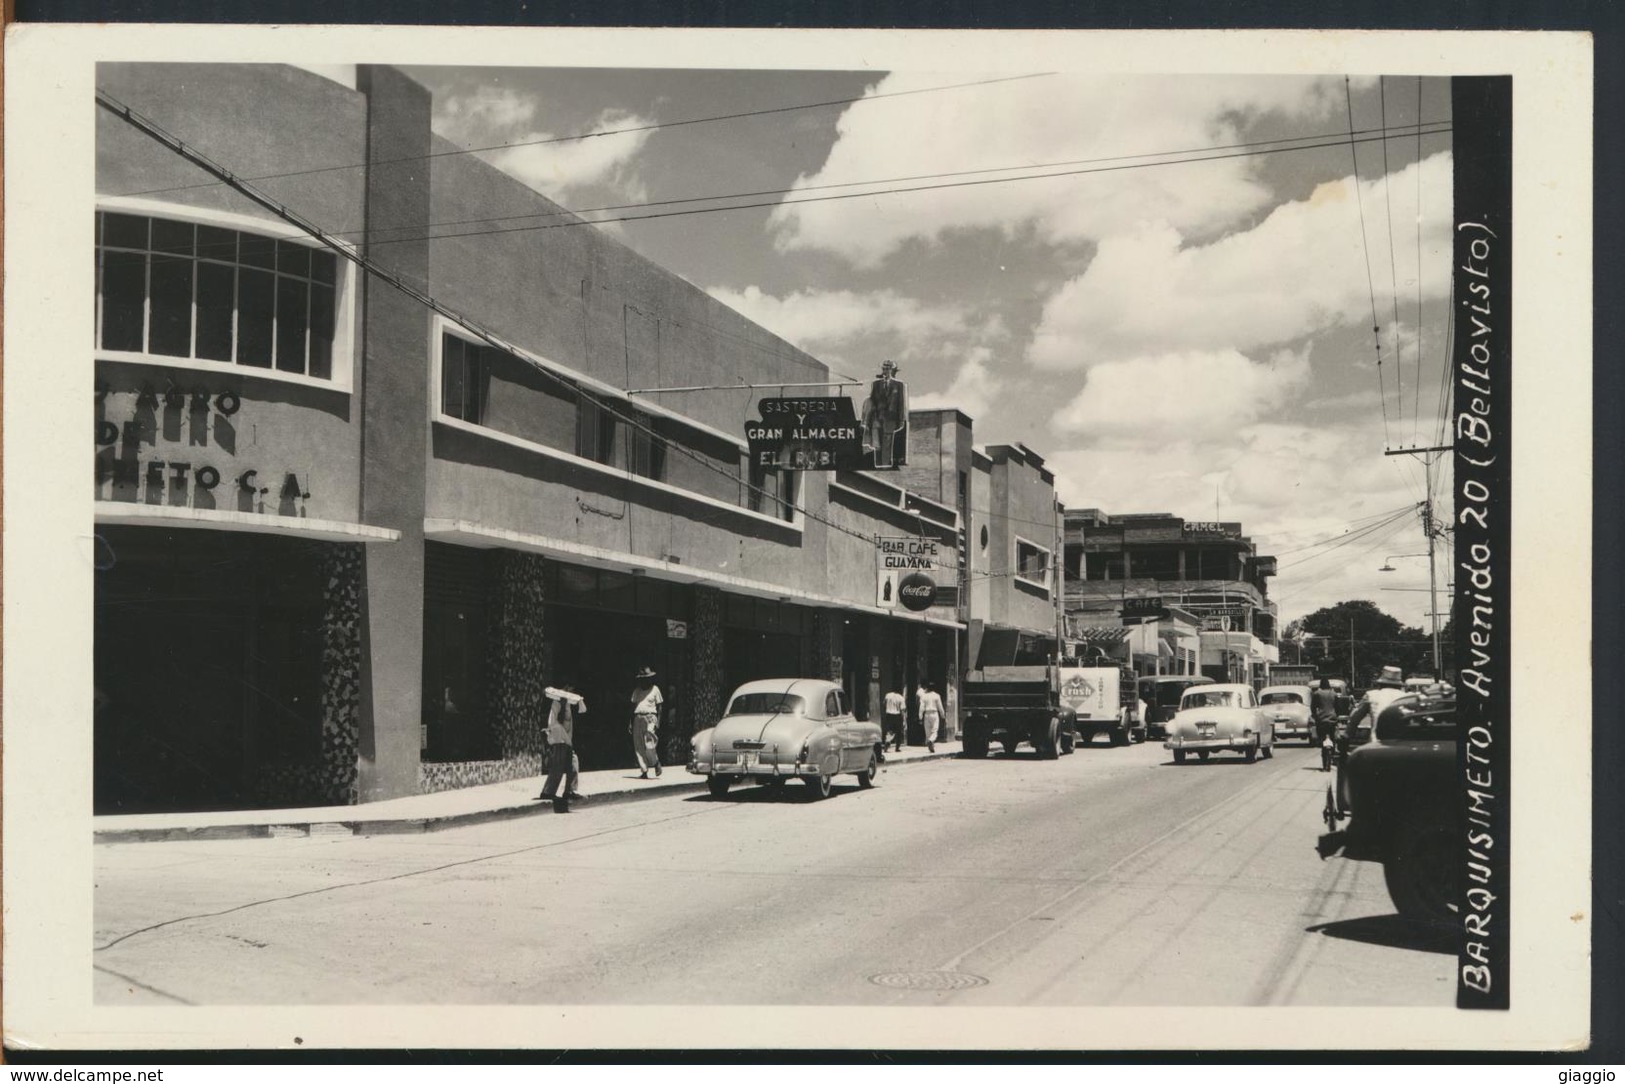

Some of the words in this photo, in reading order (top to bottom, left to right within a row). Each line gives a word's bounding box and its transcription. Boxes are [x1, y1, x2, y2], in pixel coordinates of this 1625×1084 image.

[765, 401, 837, 413] SASTRERIA
[797, 414, 806, 425] Y
[748, 428, 783, 440] GRAN
[792, 428, 855, 439] ALMACEN
[760, 451, 784, 465] EL
[1183, 522, 1224, 532] CAMEL
[882, 541, 905, 553] BAR
[909, 542, 938, 555] CAFE
[885, 556, 932, 569] GUAYANA
[1061, 685, 1092, 697] Crush
